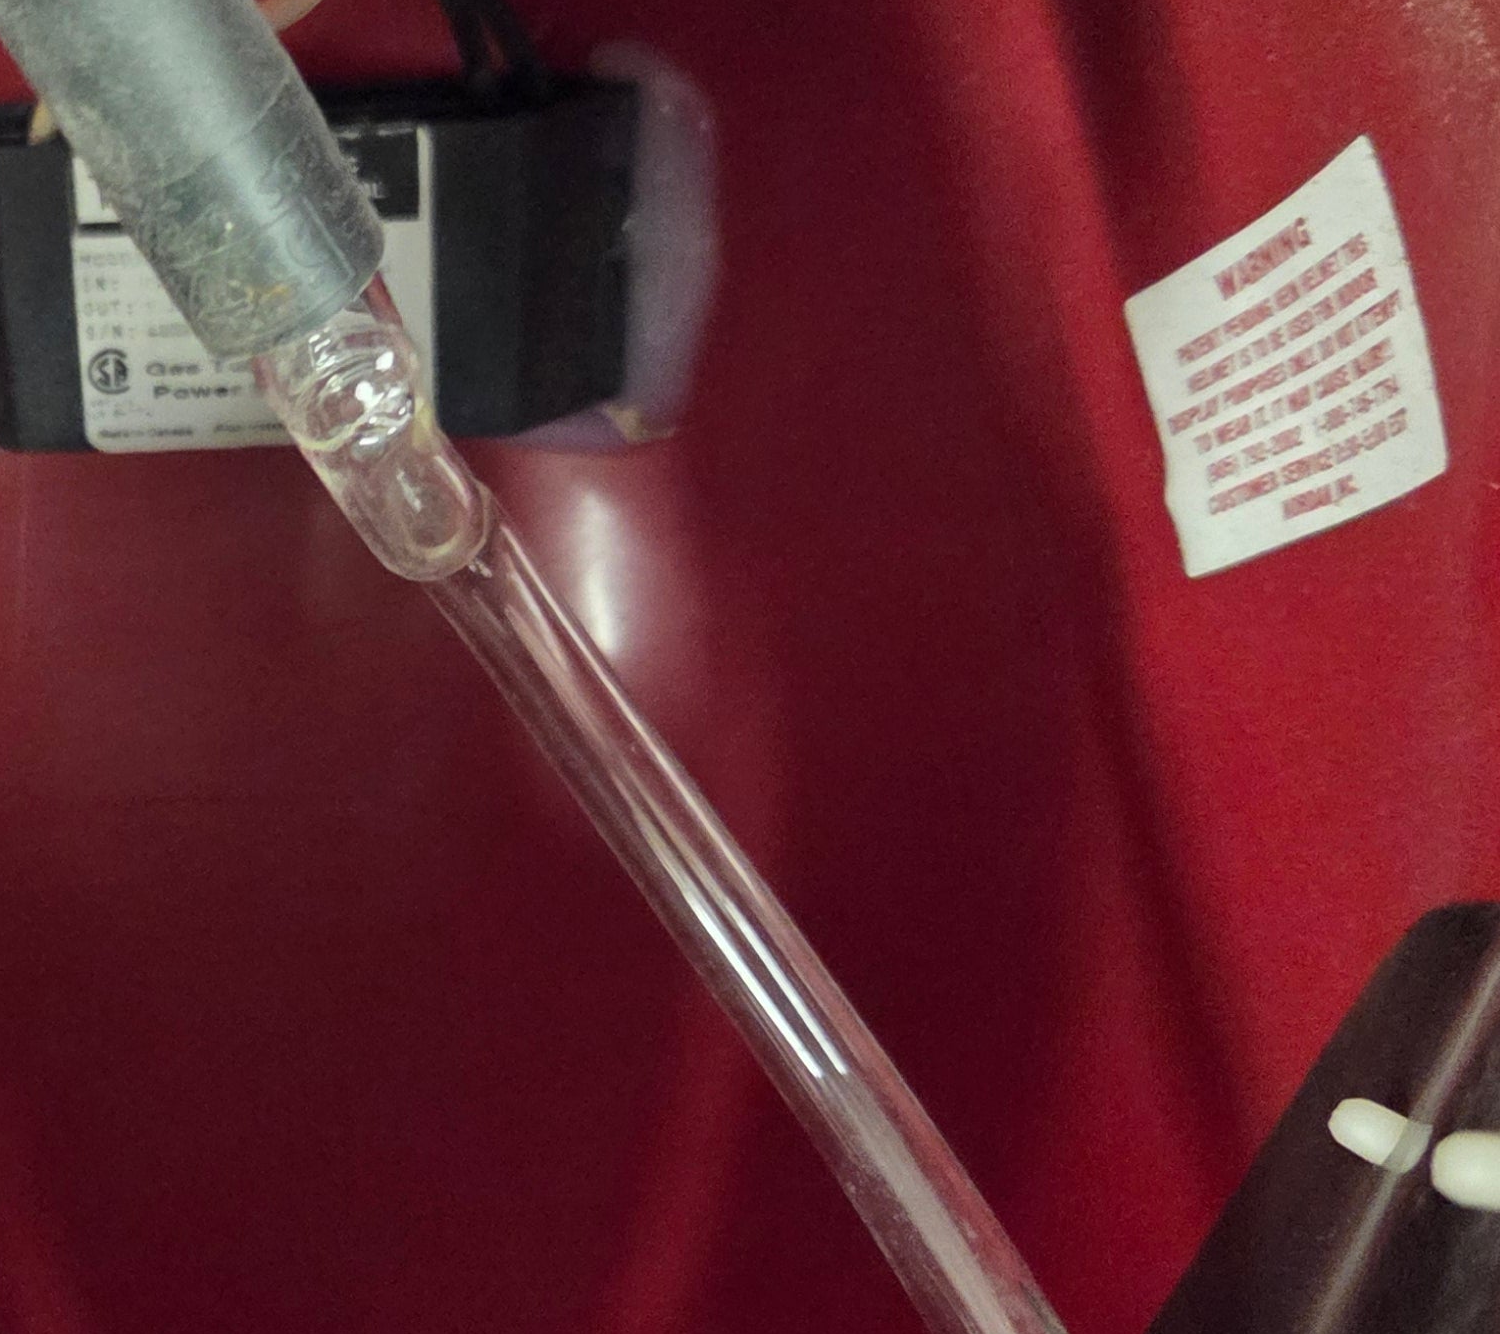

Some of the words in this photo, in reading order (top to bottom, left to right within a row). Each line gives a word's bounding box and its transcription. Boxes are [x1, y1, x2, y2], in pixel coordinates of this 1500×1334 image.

[1214, 217, 1311, 299] WARNING
[153, 385, 243, 401] Power
[1210, 471, 1279, 514] CUSTOMER
[1280, 447, 1333, 485] SERVICE
